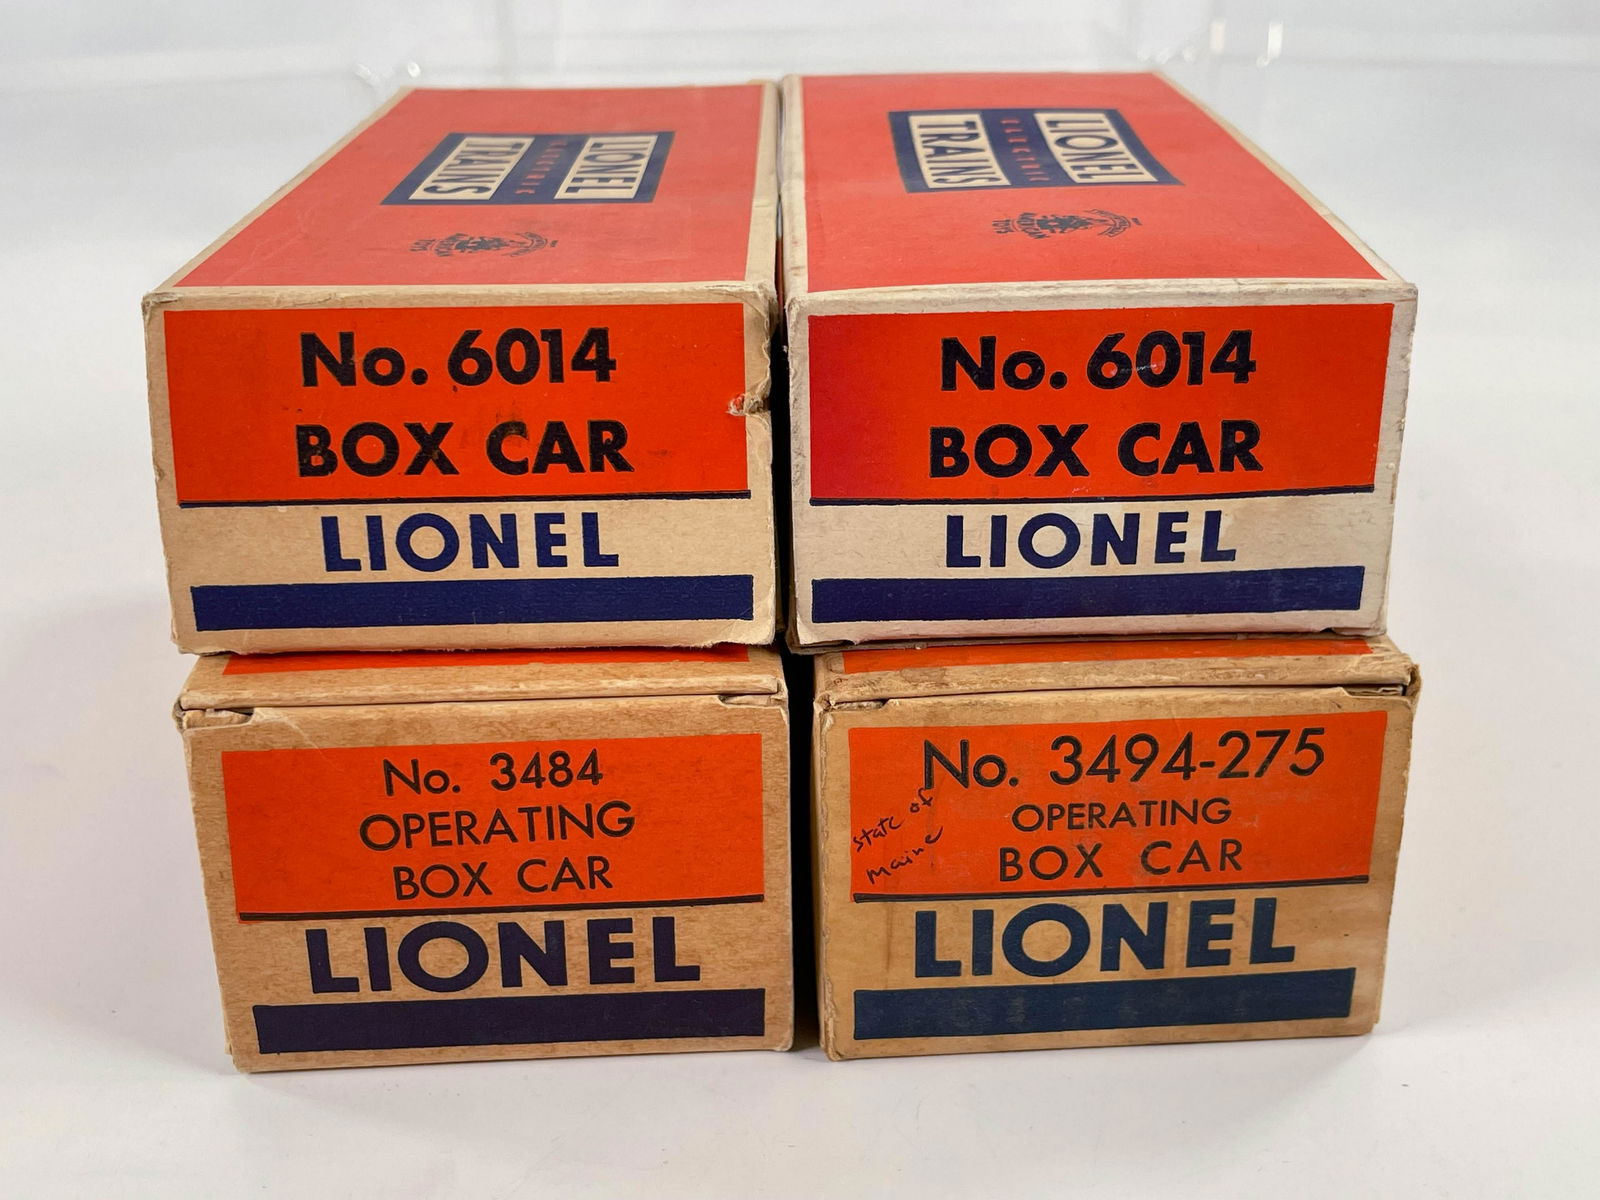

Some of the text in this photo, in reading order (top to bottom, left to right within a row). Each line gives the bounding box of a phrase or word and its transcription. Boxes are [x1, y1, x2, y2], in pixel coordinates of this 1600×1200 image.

[422, 139, 525, 195] TRAINS
[564, 139, 651, 194] LIONEL
[917, 119, 1003, 186] TRAINS
[1001, 118, 1051, 183] ELECTRIC
[1044, 118, 1145, 183] LIONEL
[300, 327, 617, 387] No. 6014
[941, 330, 1257, 391] No. 6014
[296, 420, 634, 477] BOX CAR
[930, 419, 1263, 478] BOX CAR
[321, 511, 619, 572] LIONEL
[945, 510, 1237, 569] LIONEL
[382, 748, 604, 798] No. 3484
[923, 727, 1325, 790] No. 3494-275
[359, 800, 636, 852] OPERATING
[910, 788, 933, 813] of
[1011, 797, 1232, 833] OPERATING
[393, 856, 614, 901] BOX CAR
[998, 839, 1243, 883] BOX CAR
[305, 916, 701, 994] LIONEL
[914, 897, 1296, 979] LIONEL
